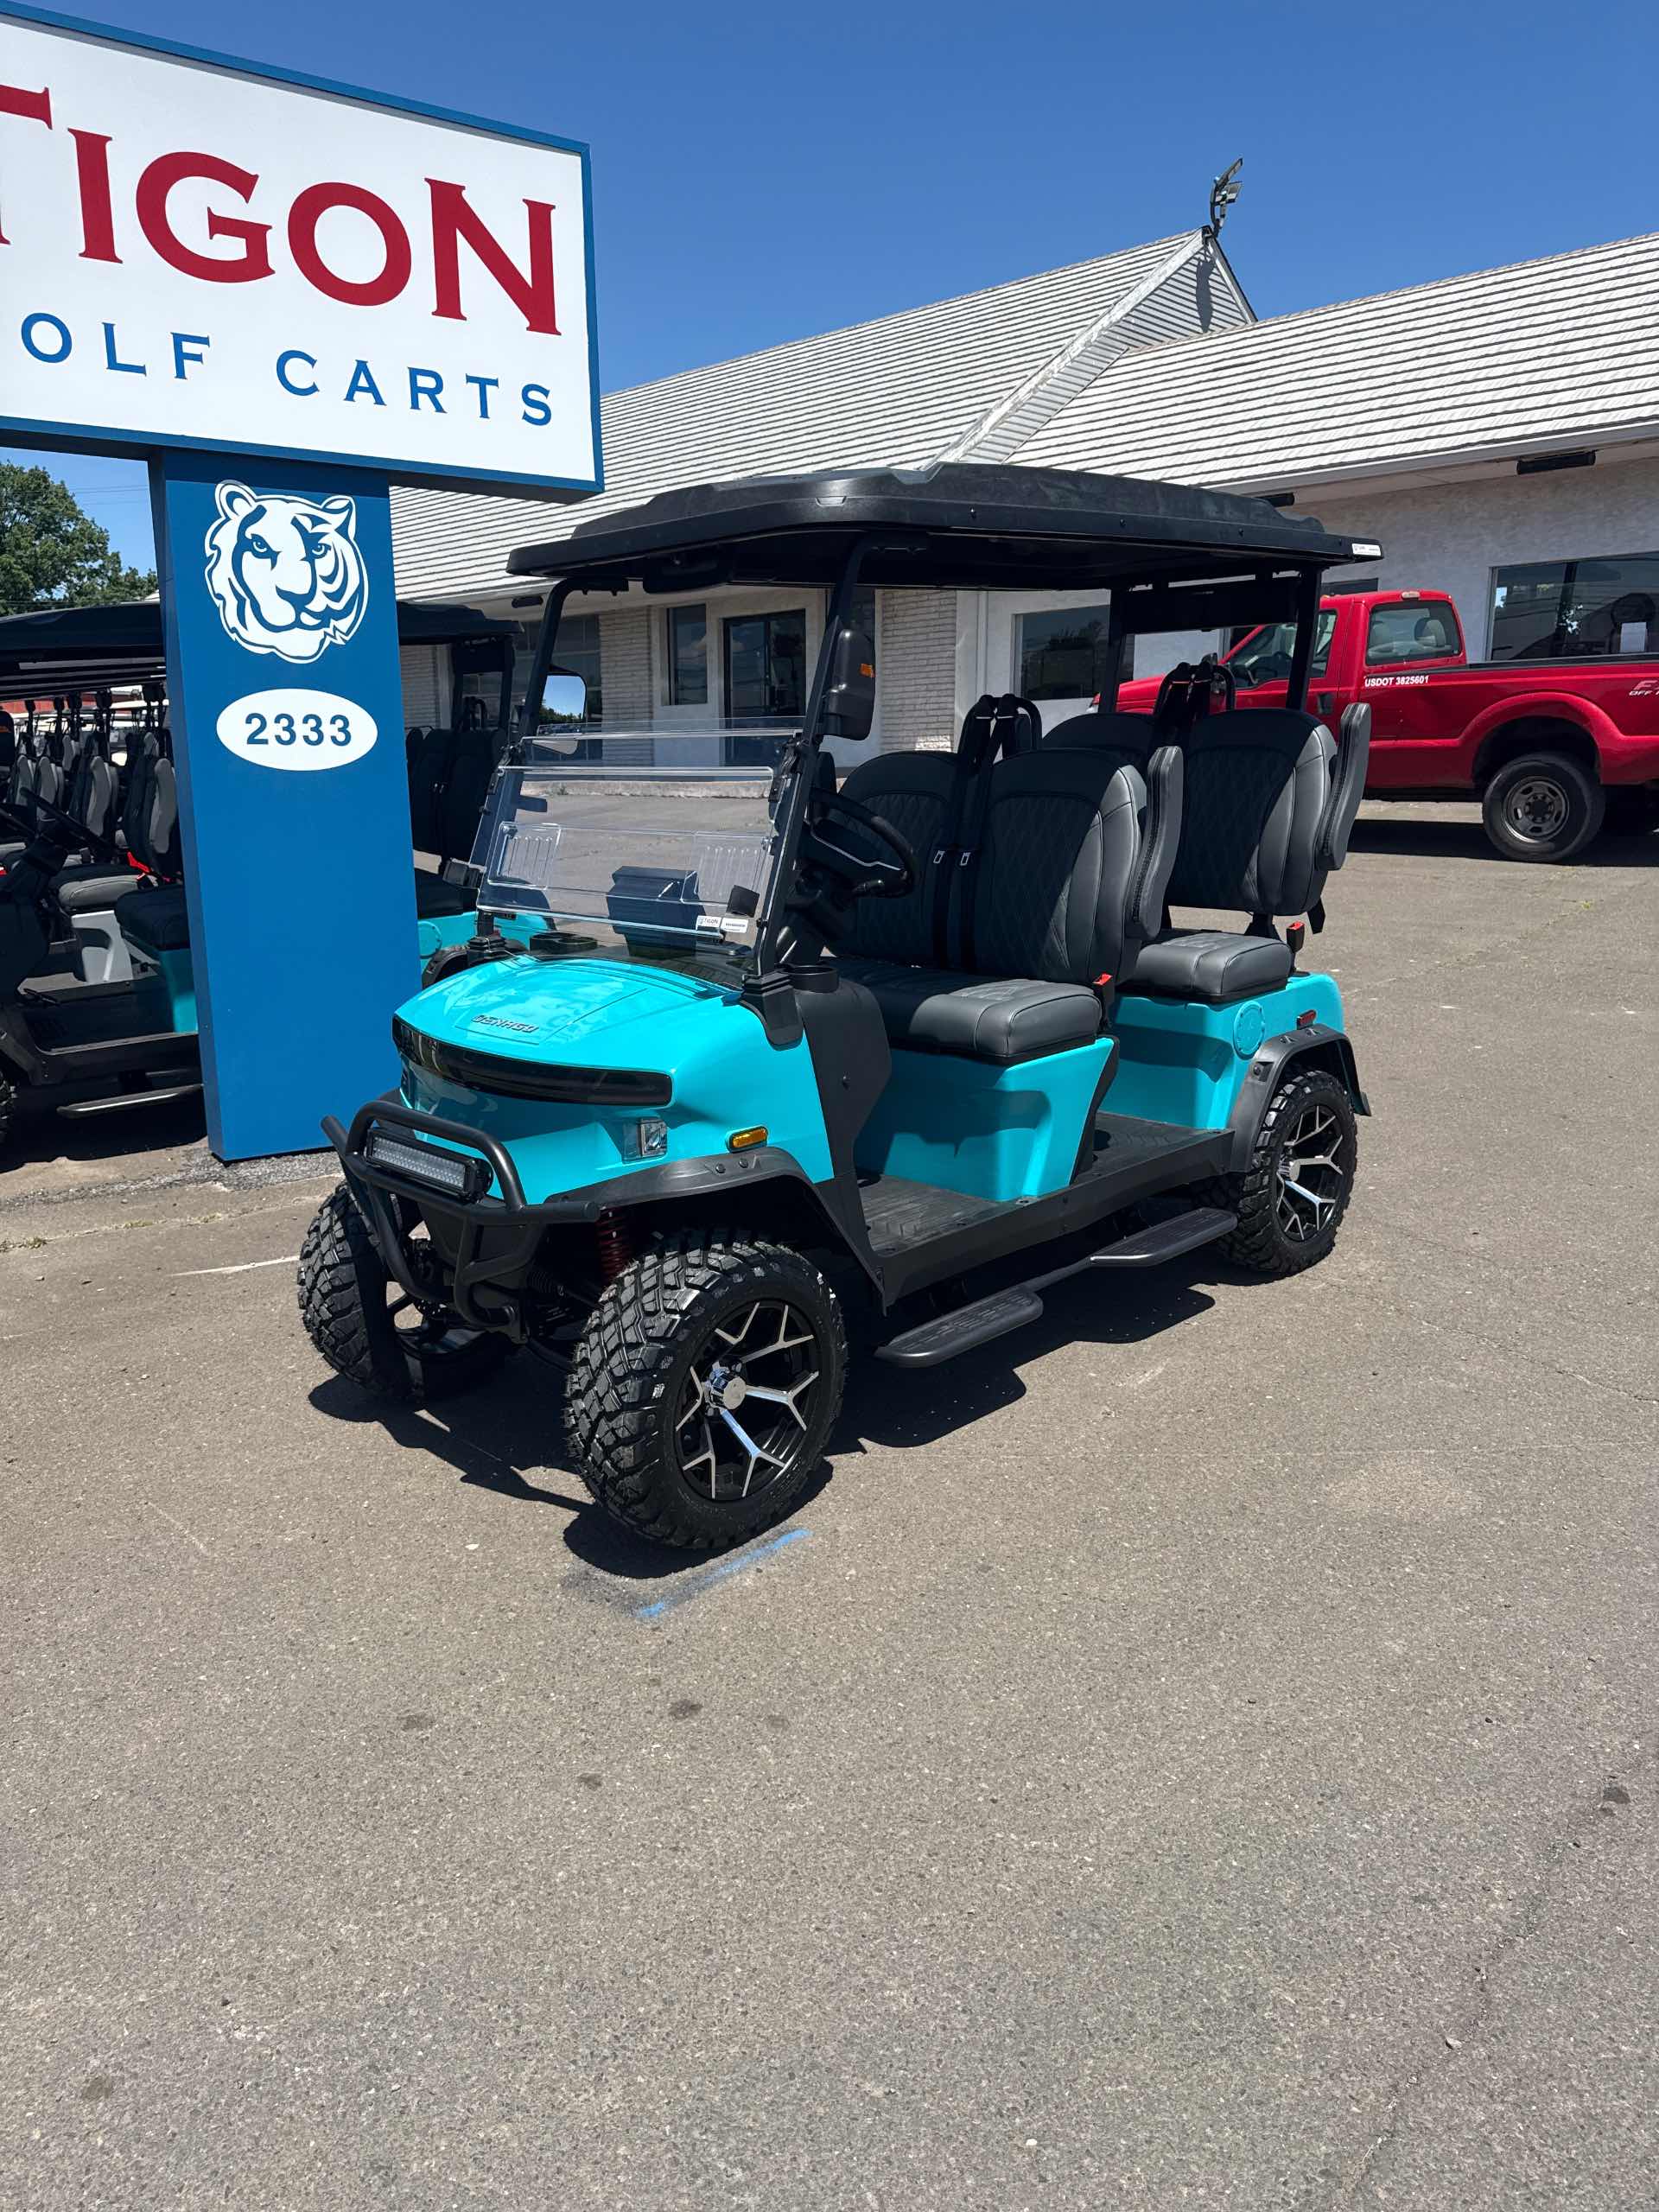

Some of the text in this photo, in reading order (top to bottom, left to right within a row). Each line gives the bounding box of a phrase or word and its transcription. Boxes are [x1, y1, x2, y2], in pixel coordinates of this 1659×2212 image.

[276, 349, 553, 427] CARTS
[1364, 675, 1429, 687] USDOT 3825601
[245, 712, 353, 747] 2333
